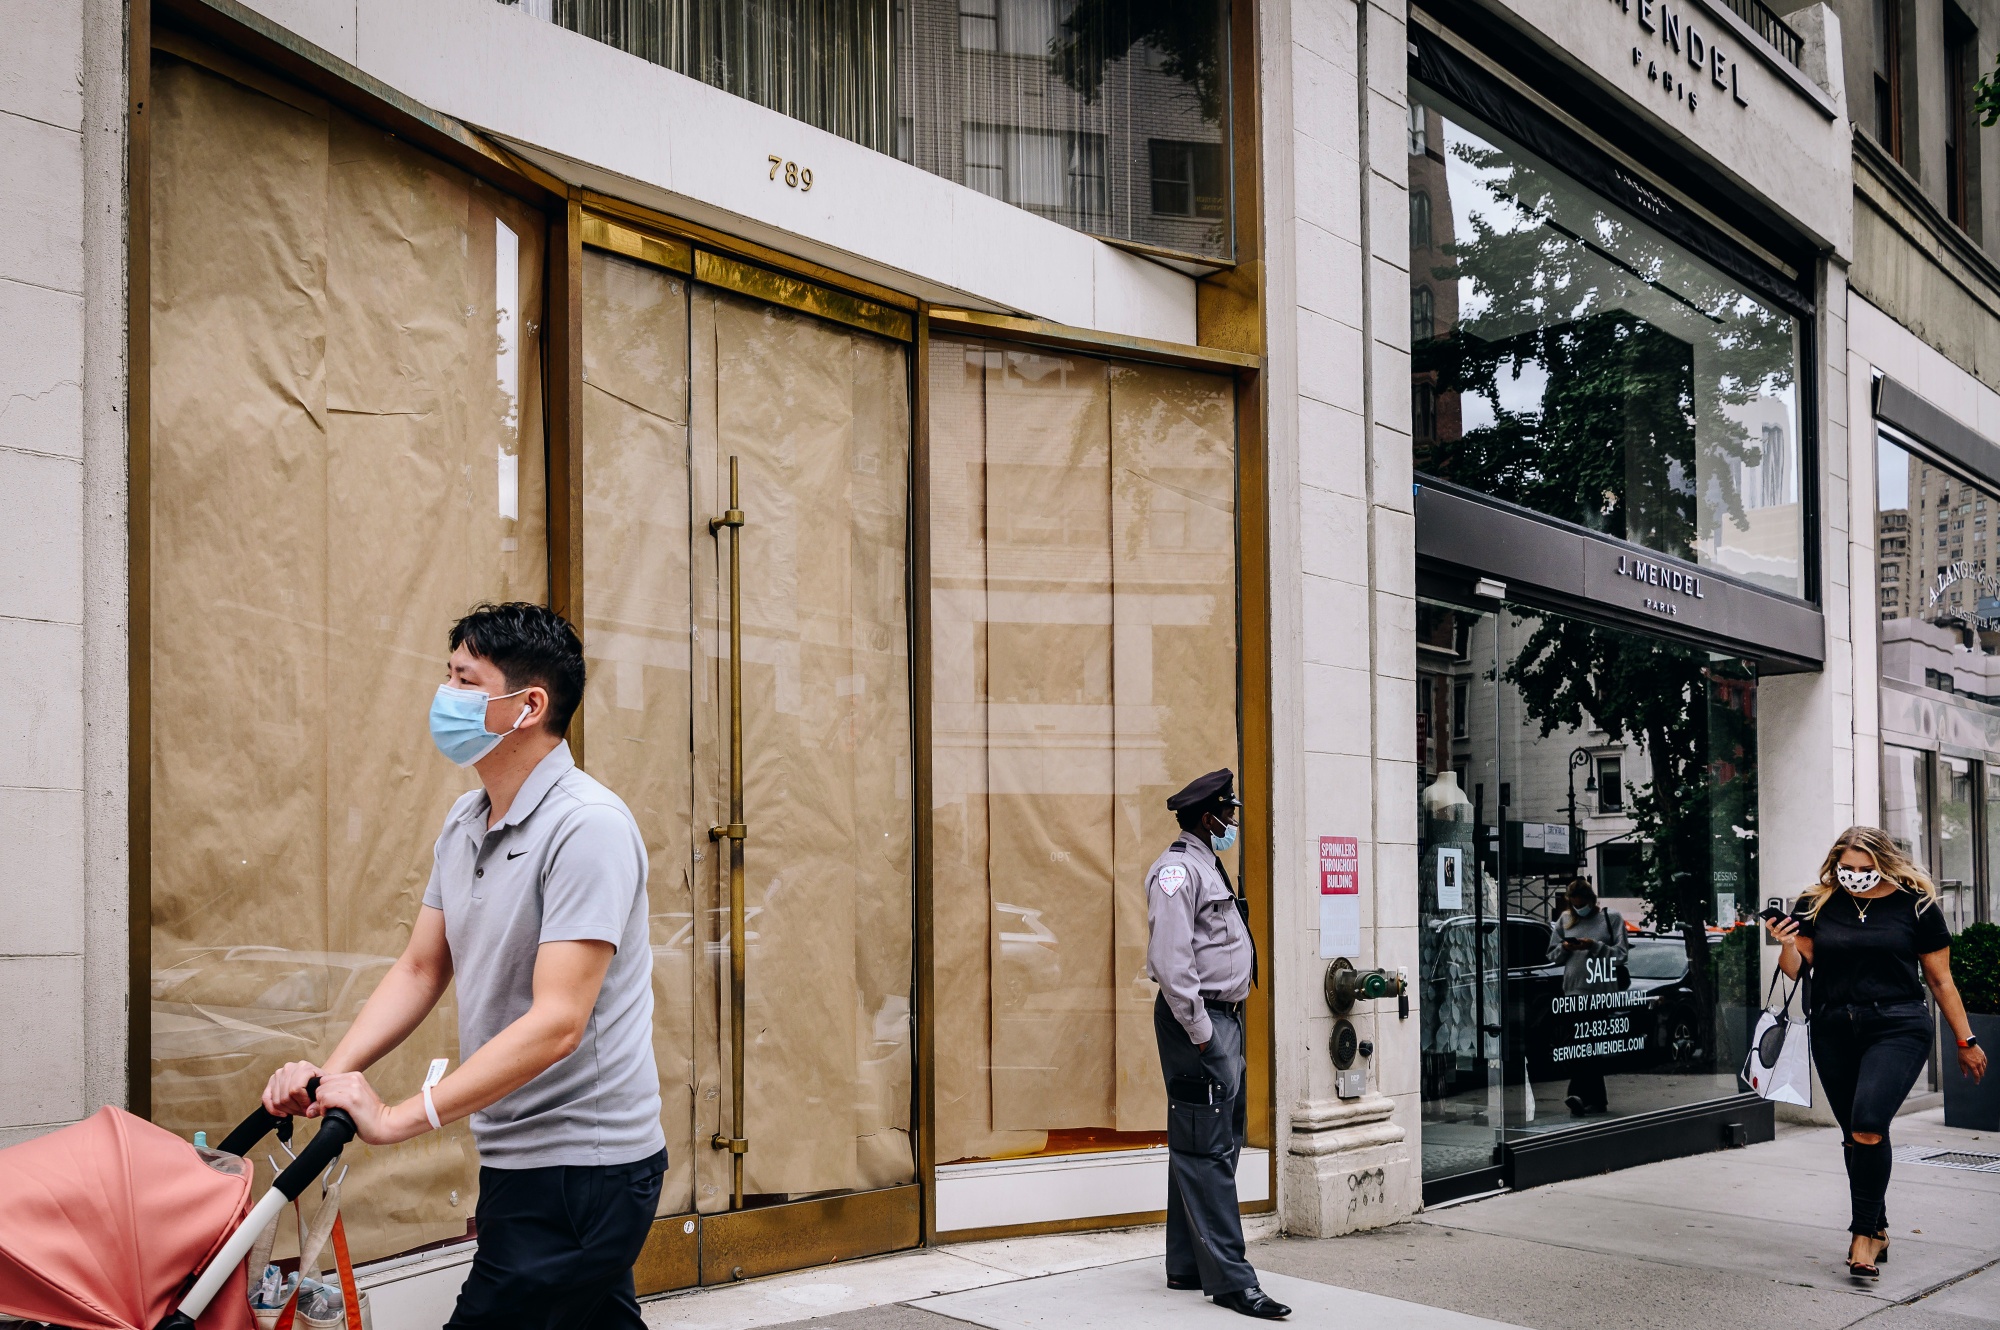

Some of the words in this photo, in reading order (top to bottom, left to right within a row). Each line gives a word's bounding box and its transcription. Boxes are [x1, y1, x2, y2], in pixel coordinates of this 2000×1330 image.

[1608, 0, 1749, 108] ENDEL
[1632, 46, 1698, 112] PARIS
[768, 154, 814, 192] 789
[1617, 555, 1705, 599] J.MENDEL
[1645, 598, 1677, 616] PARIS
[1321, 843, 1356, 857] SPRINKLERS
[1321, 858, 1357, 872] THROUGHOUT
[1326, 874, 1353, 889] BUILDING
[1585, 956, 1618, 984] SALE
[1551, 994, 1576, 1014] OPEN
[1578, 995, 1589, 1012] BY
[1589, 989, 1648, 1011] APPOINTMENT
[1574, 1017, 1630, 1039] 212-832-5830
[1552, 1037, 1645, 1062] SERVICE@JMENDEL.COM
